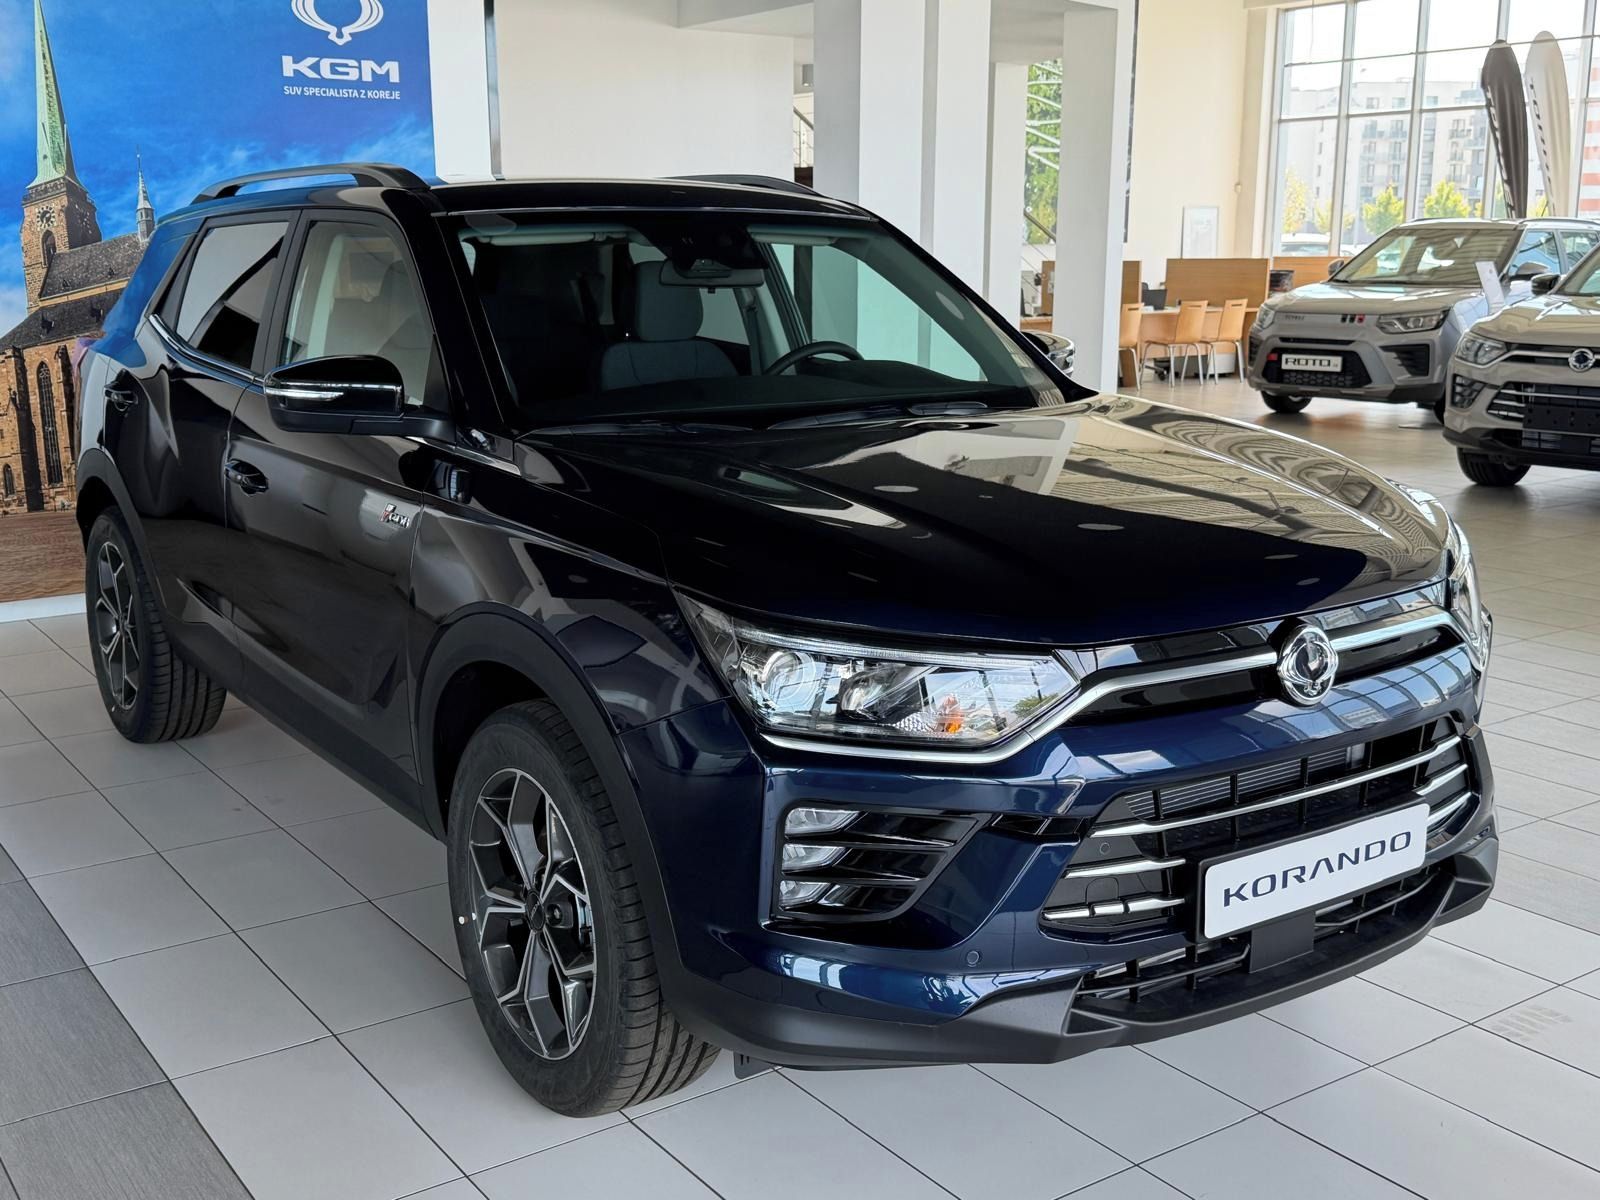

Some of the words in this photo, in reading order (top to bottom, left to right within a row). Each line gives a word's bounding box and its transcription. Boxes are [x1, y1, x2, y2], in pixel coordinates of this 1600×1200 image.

[281, 55, 400, 83] KGM
[283, 85, 302, 95] SUV
[303, 86, 359, 98] SPECIALISTA
[360, 89, 366, 98] Z
[367, 90, 401, 100] KOREJE
[1285, 357, 1331, 367] ROTO
[1223, 831, 1412, 907] KORANDO
